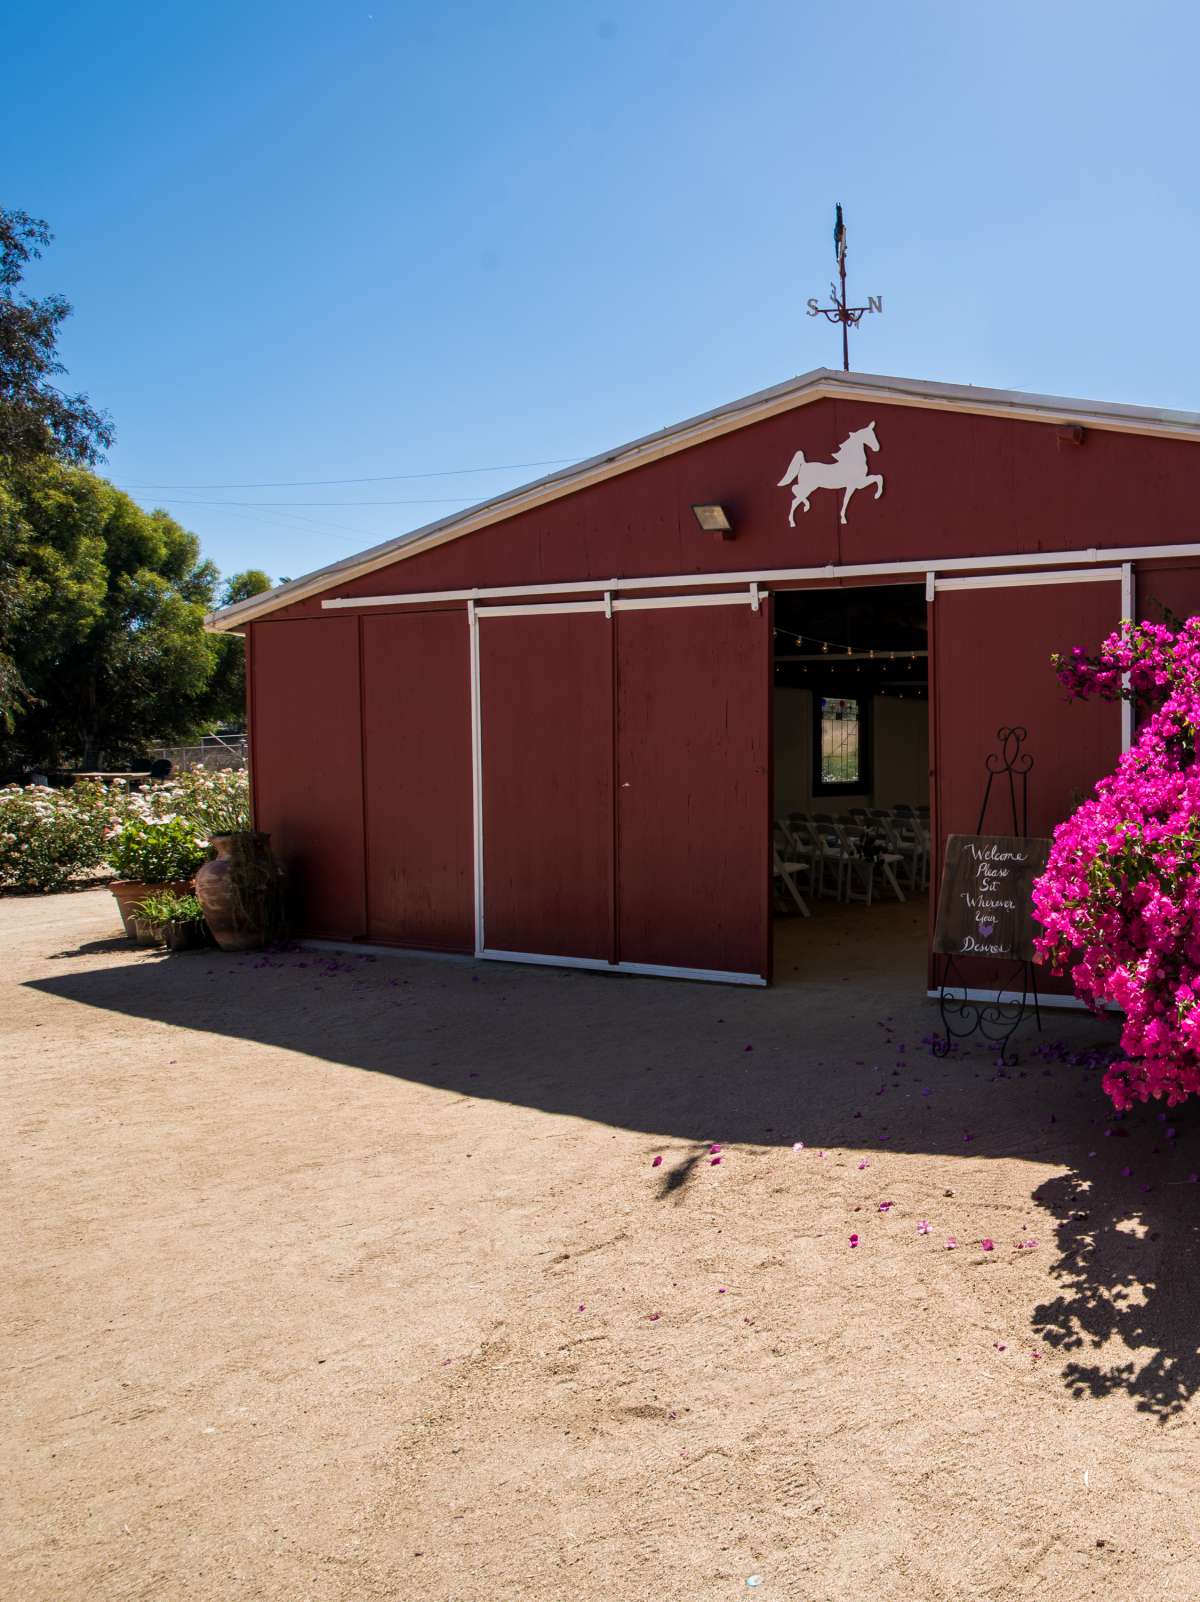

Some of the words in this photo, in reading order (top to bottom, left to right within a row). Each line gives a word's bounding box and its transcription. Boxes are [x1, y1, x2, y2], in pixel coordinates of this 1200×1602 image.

[806, 298, 819, 317] S
[867, 295, 883, 313] N
[963, 843, 1028, 861] Welcome
[975, 862, 1009, 878] Please
[979, 877, 1001, 892] Sit
[960, 892, 1016, 909] Wherever
[975, 910, 999, 924] Your
